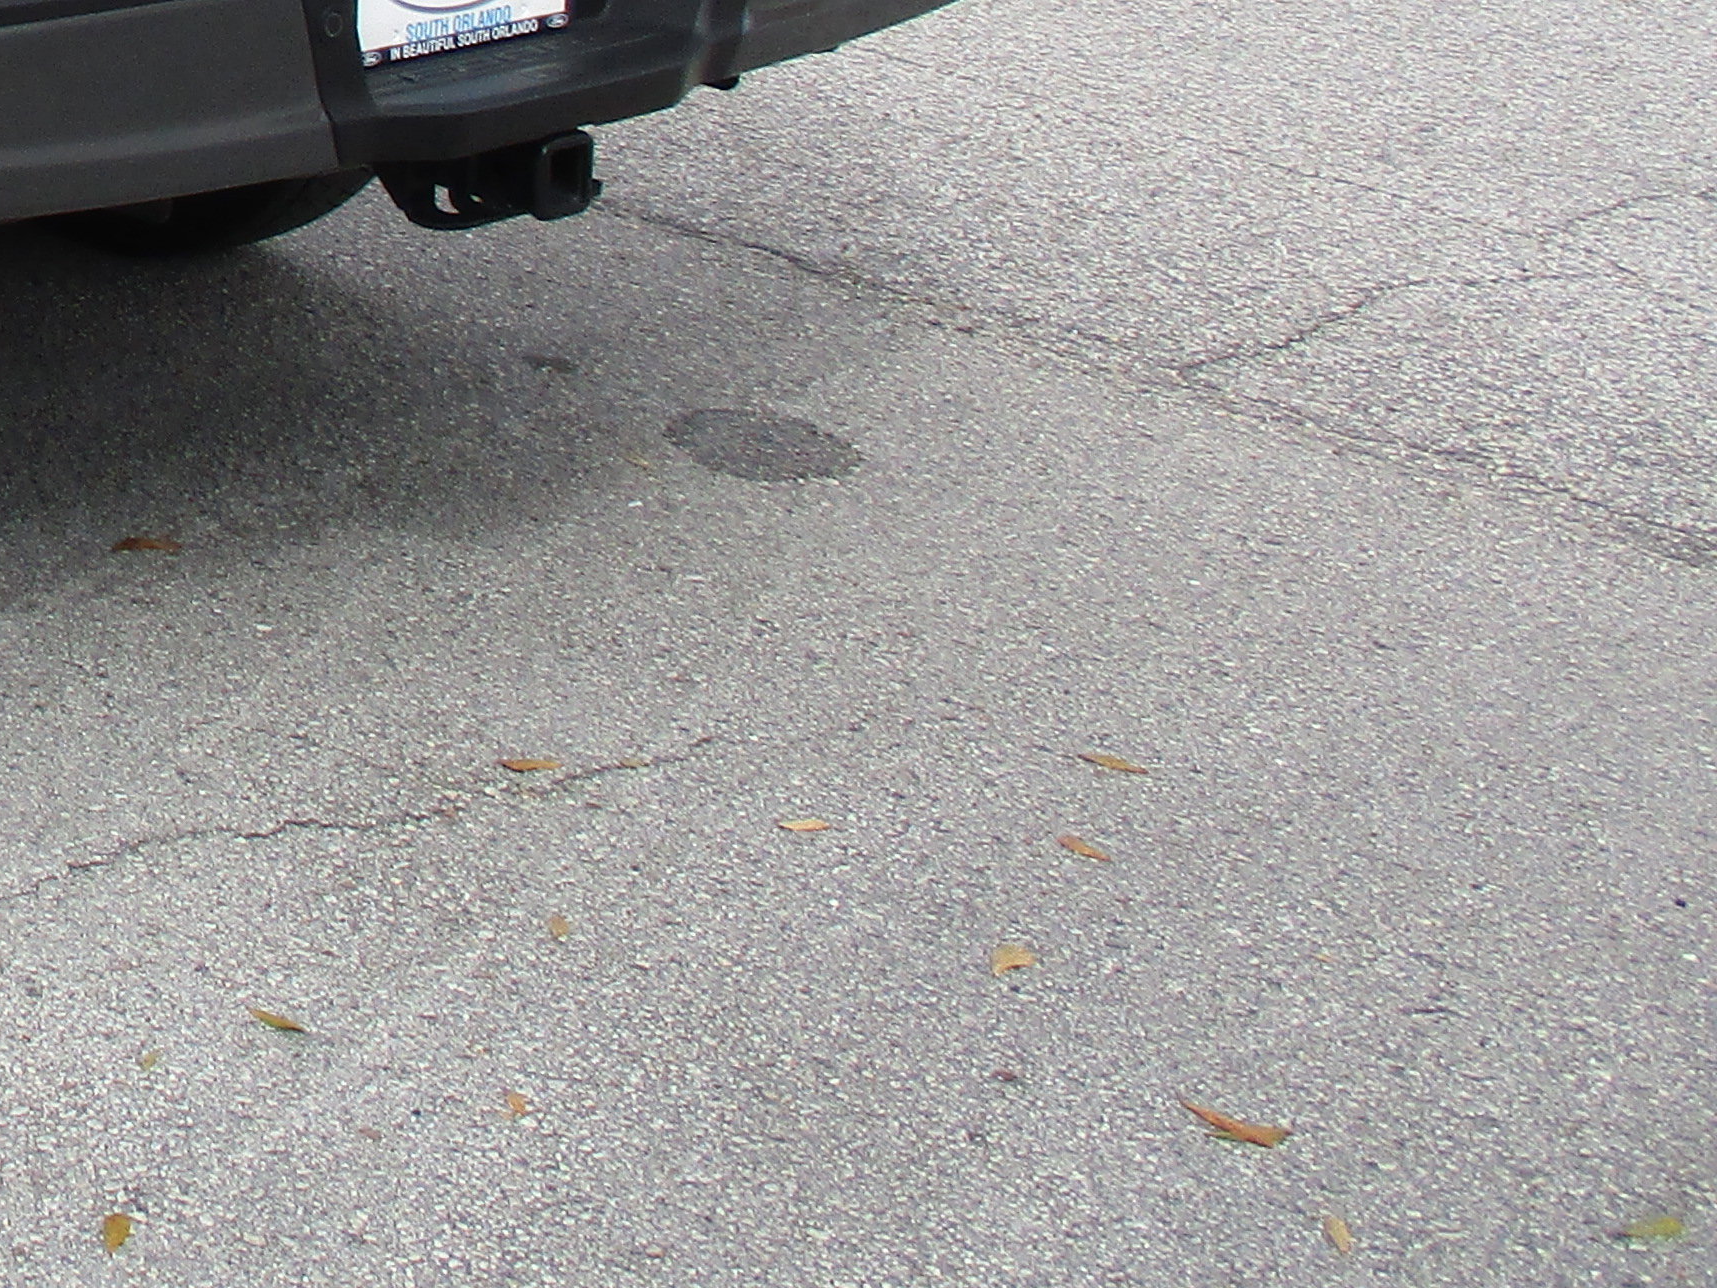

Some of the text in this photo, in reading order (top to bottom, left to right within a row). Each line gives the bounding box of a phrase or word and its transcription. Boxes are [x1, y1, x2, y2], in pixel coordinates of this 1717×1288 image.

[390, 47, 401, 61] IN
[402, 39, 456, 59] BEAUTIFUL
[457, 32, 491, 48] SOUTH
[492, 19, 539, 40] ORLANDO
[405, 5, 512, 43] SOUTH ORLANDO
